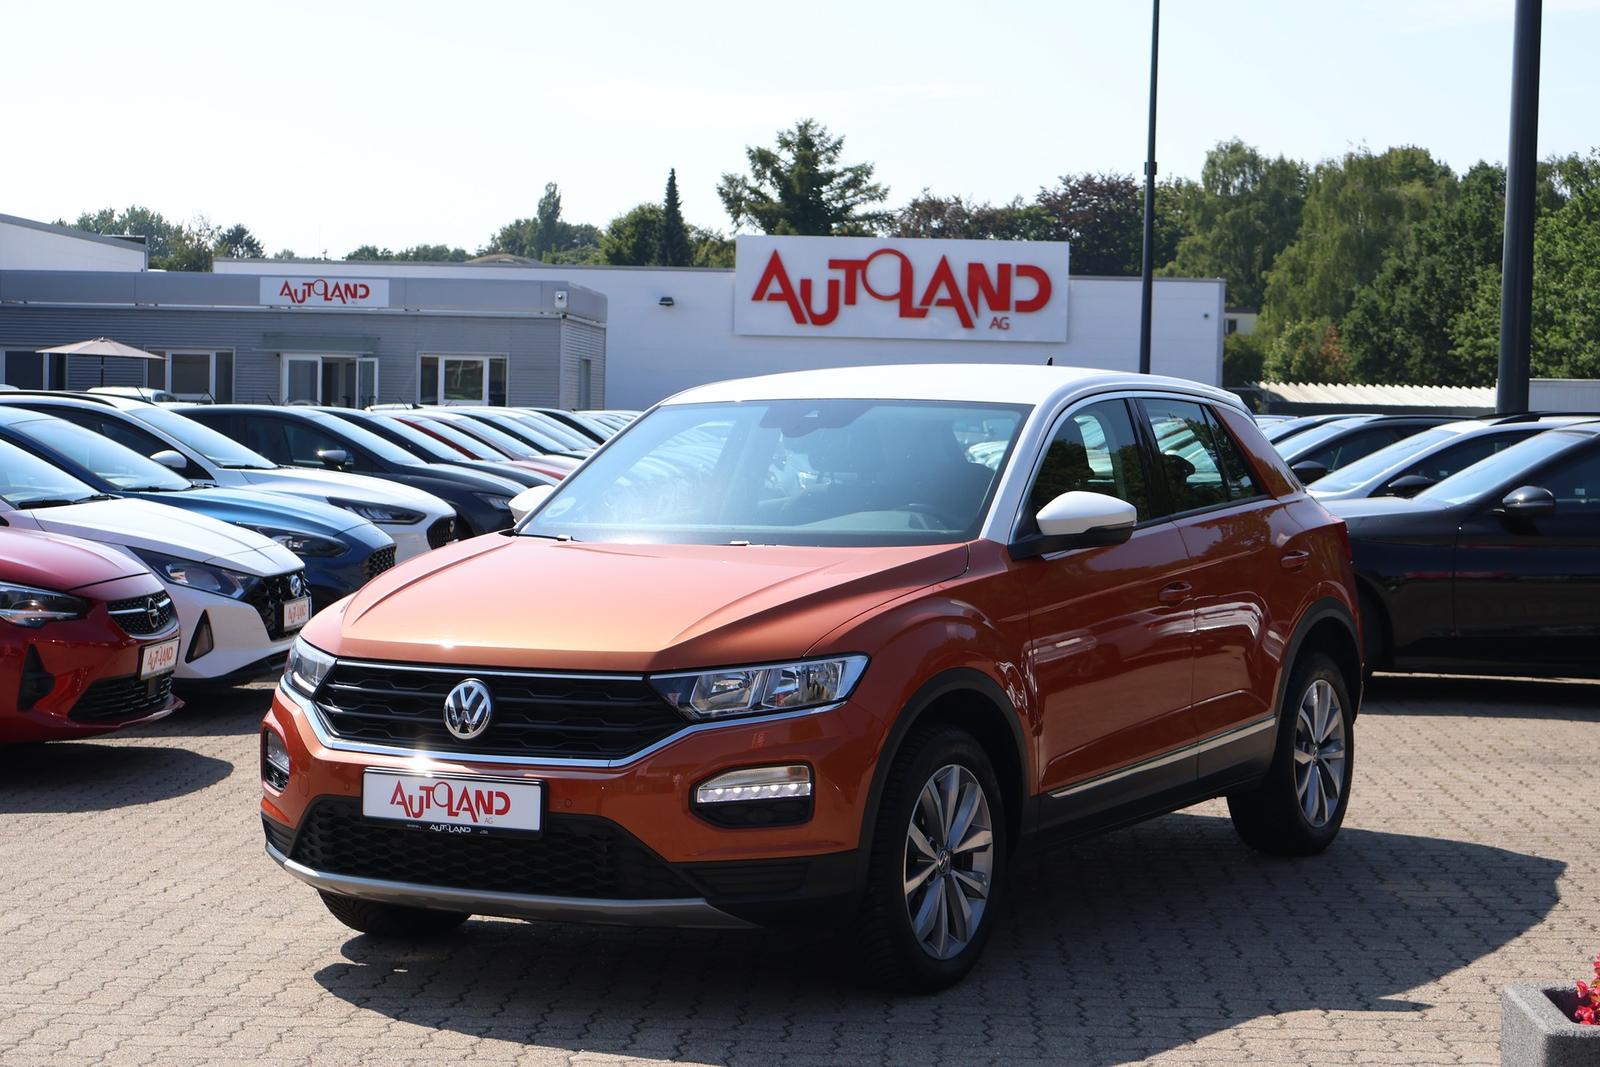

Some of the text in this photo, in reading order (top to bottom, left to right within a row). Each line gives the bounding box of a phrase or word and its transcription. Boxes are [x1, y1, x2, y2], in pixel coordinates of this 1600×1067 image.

[279, 278, 370, 304] AUTOLAND
[751, 248, 1052, 329] AUTOLAND
[989, 316, 1010, 330] AG
[444, 677, 492, 740] VW
[390, 780, 511, 823] AUTOLAND
[429, 823, 472, 834] AUTOLAND
[484, 817, 494, 825] AG
